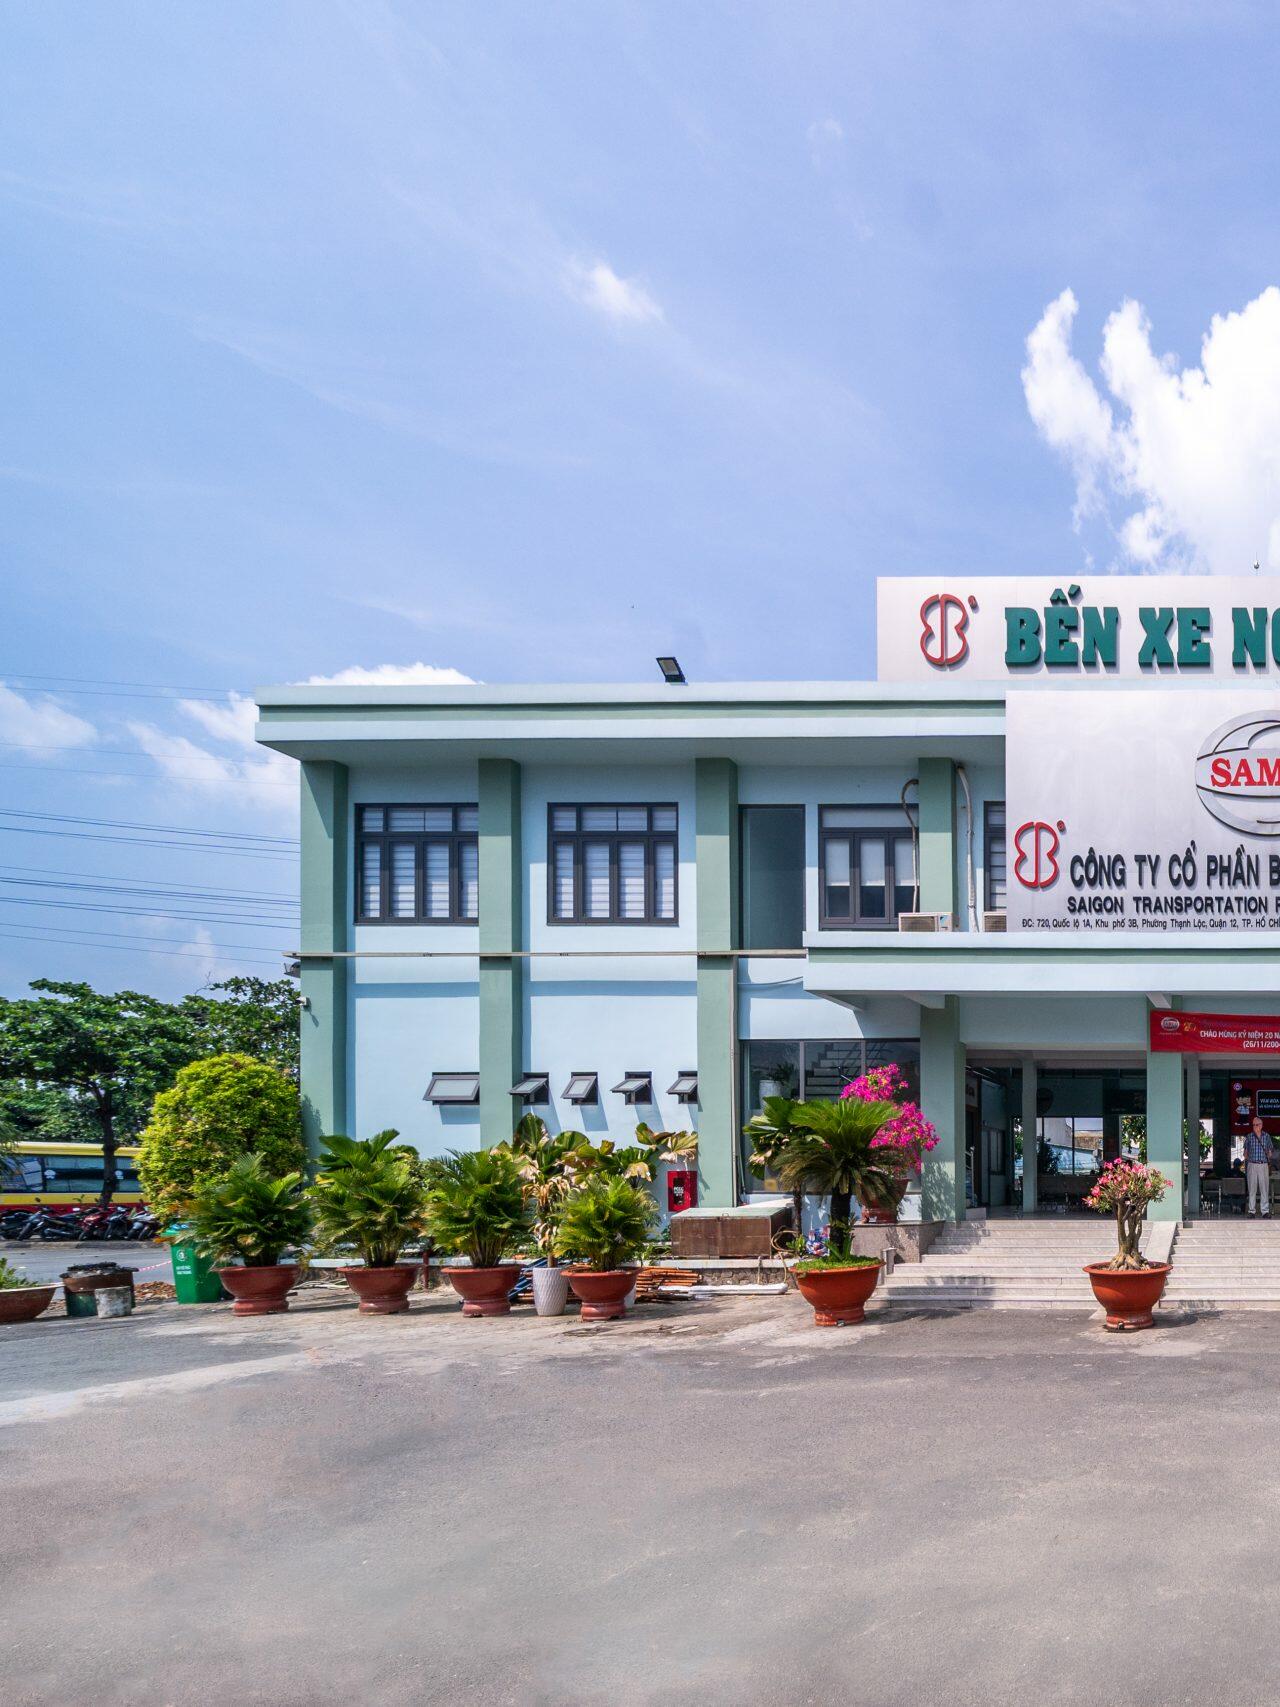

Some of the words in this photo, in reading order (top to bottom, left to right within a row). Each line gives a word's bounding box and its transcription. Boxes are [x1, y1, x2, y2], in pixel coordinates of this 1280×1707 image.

[1005, 584, 1119, 666] BẾN
[1138, 607, 1211, 667] XE
[1070, 847, 1126, 888] CÔNG
[1135, 854, 1160, 887] TY
[1169, 840, 1197, 888] CỔ
[1206, 844, 1260, 887] PHẦN
[1067, 896, 1124, 914] SAIGON
[1133, 896, 1268, 914] TRANSPORTATION
[1037, 918, 1051, 930] 720,
[1052, 917, 1070, 930] Quốc
[1095, 918, 1109, 928] Khu
[1113, 917, 1126, 930] phố
[1128, 918, 1139, 929] 3B,
[1230, 919, 1239, 930] 12,
[1242, 918, 1253, 928] TP.
